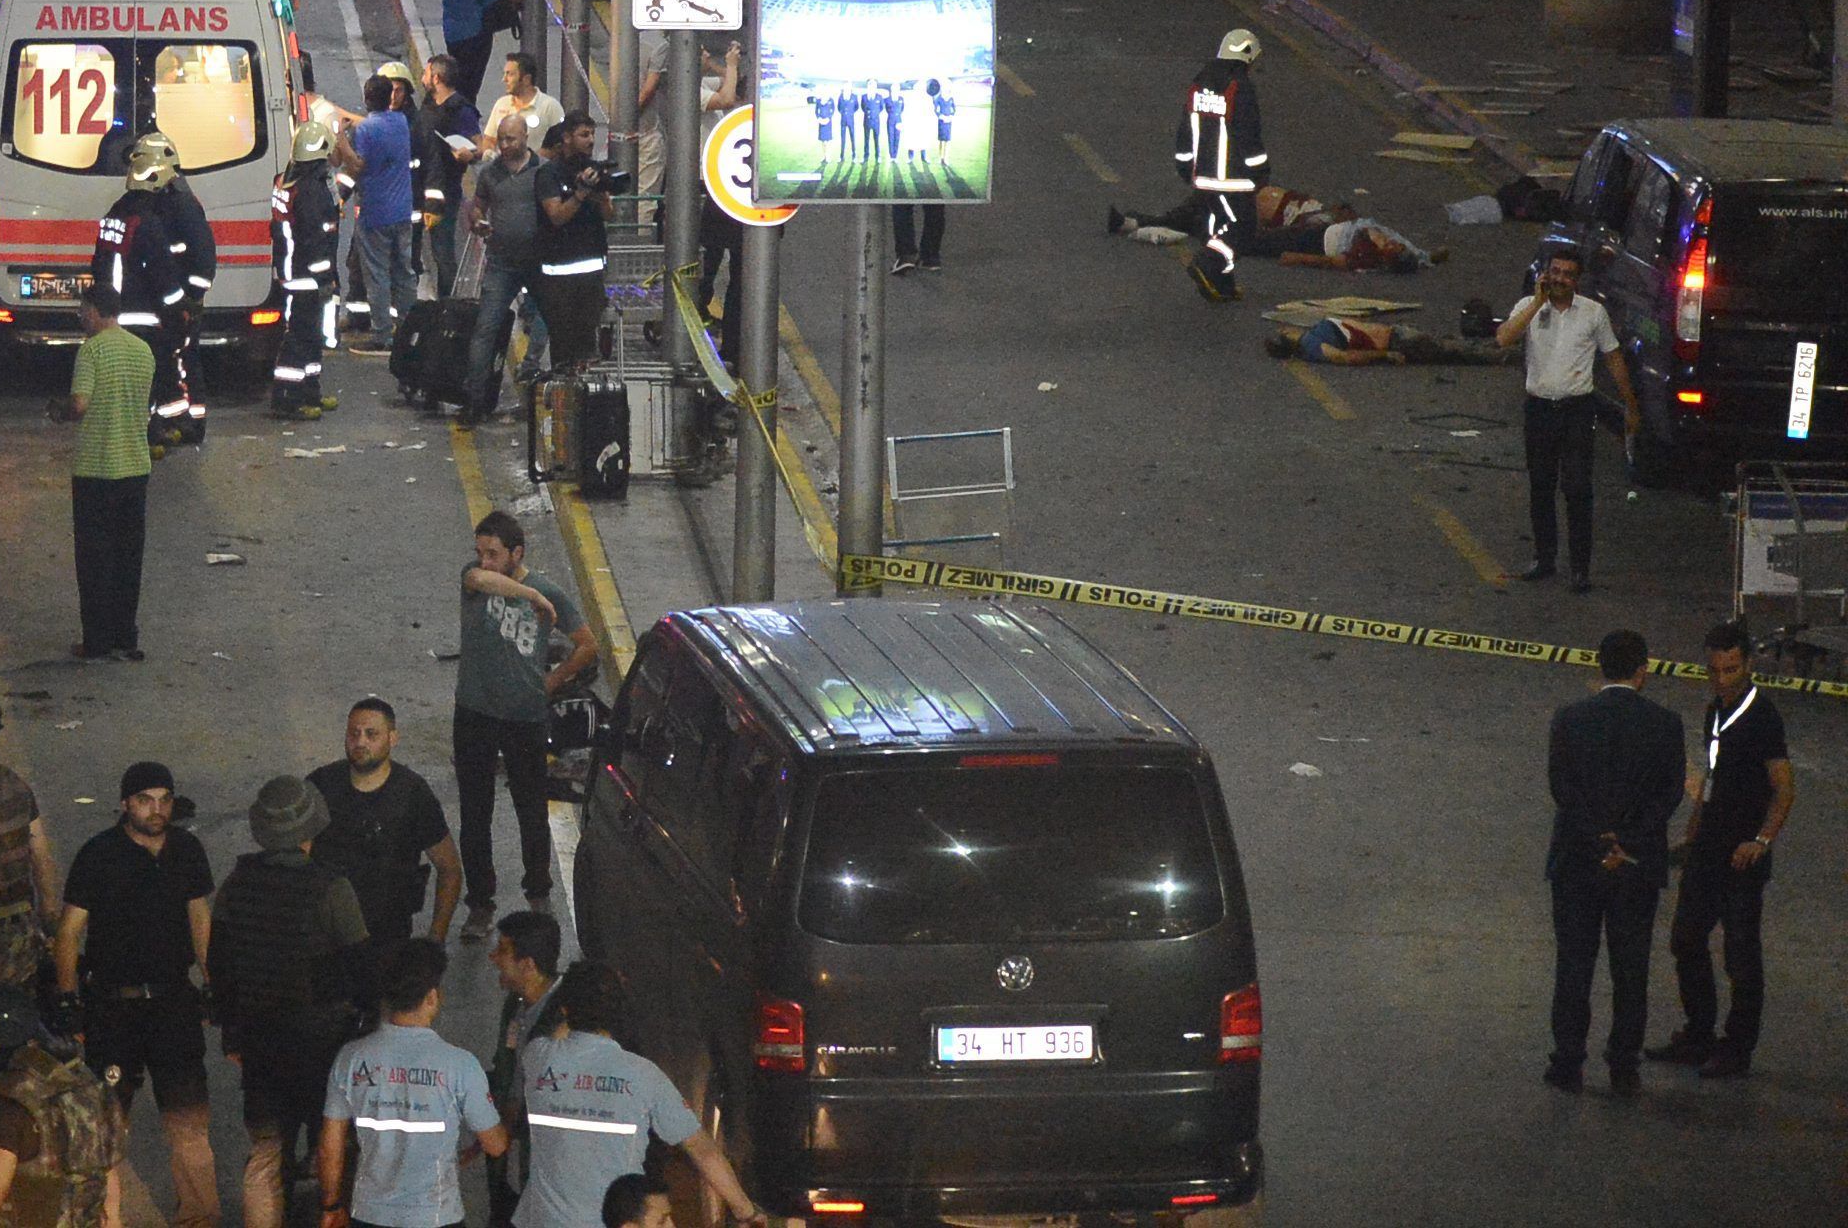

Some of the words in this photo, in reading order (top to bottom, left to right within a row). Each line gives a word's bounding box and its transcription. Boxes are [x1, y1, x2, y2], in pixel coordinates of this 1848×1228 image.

[35, 5, 229, 32] AMBULANS
[22, 69, 107, 134] 112
[1797, 346, 1814, 379] 6216
[1794, 386, 1809, 402] TP
[1791, 411, 1807, 428] 34
[850, 558, 916, 578] POLİS
[948, 569, 1054, 595] GİRİLMEZ
[1089, 586, 1155, 607] POLİS
[1332, 617, 1400, 639] POLİS
[958, 1034, 982, 1055] 34
[1003, 1033, 1026, 1055] HT
[1046, 1032, 1084, 1054] 936
